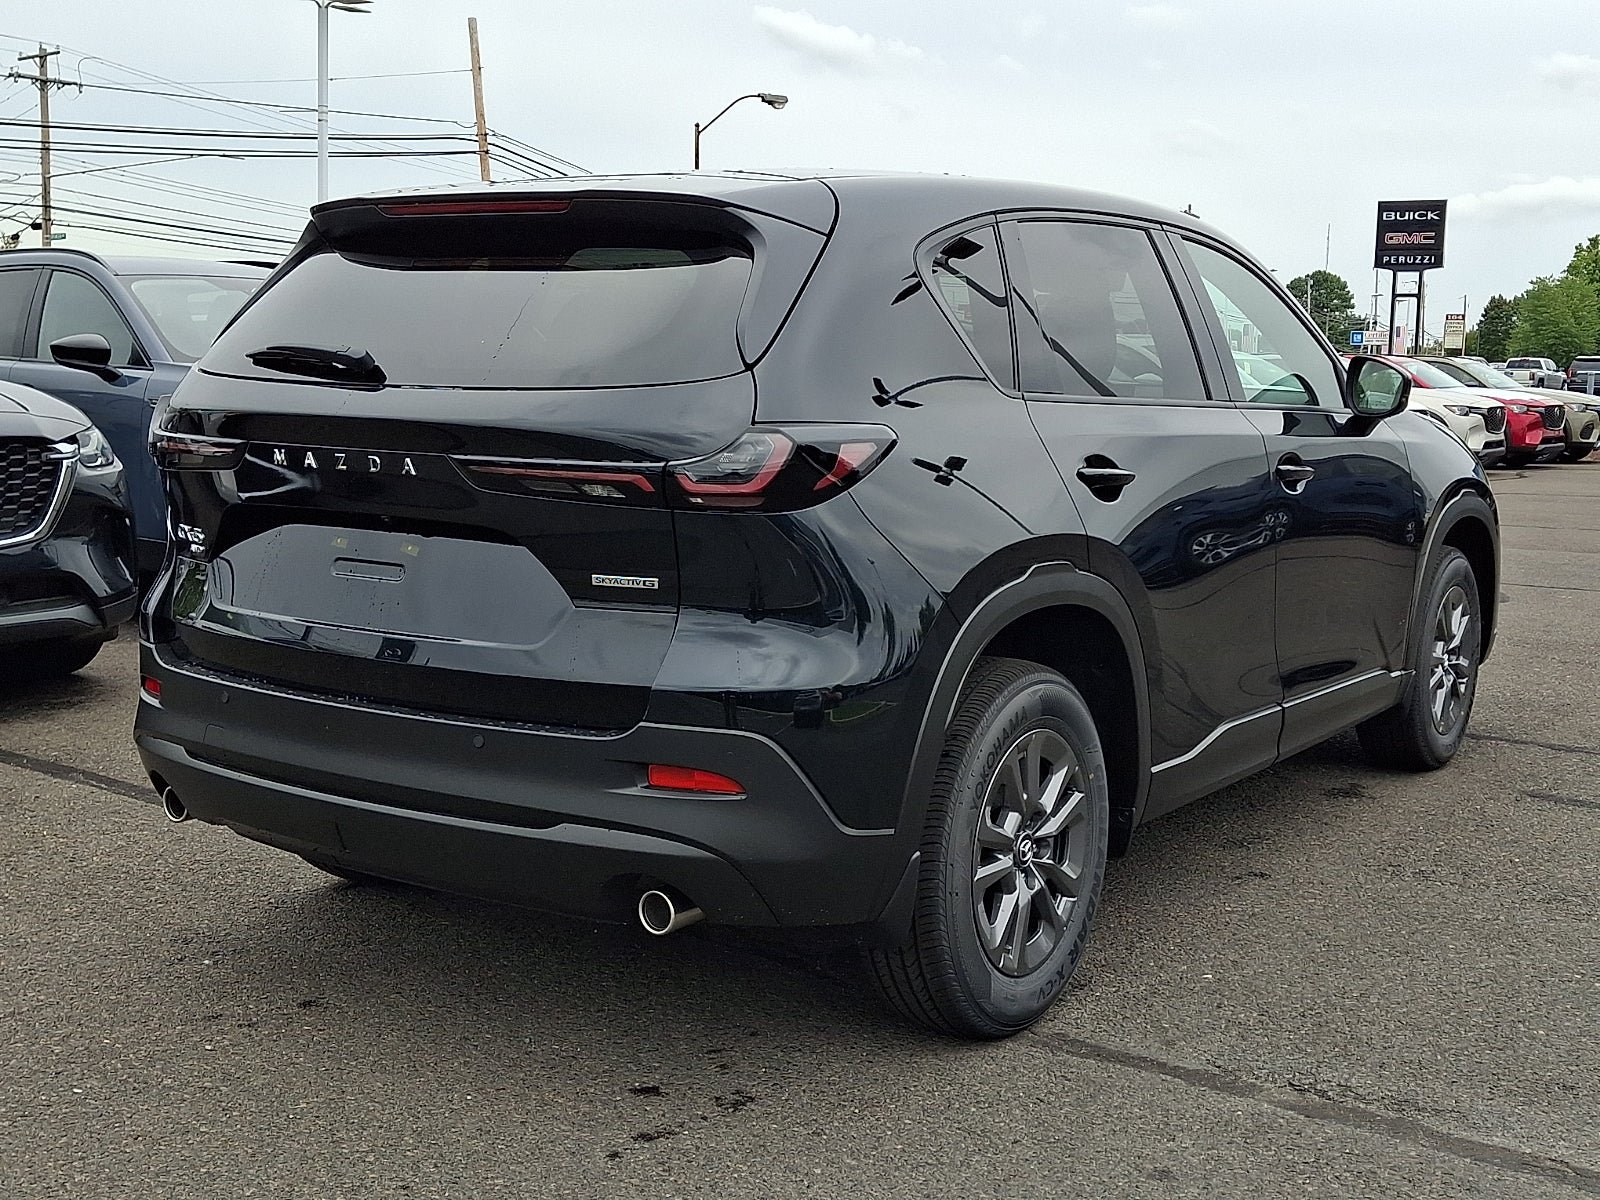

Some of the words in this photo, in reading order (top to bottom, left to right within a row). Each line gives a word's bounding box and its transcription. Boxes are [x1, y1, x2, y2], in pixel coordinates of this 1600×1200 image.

[1383, 211, 1440, 220] BUICK
[1385, 232, 1436, 244] GMC
[273, 449, 417, 476] MAZDA
[969, 705, 1028, 811] YOKOHAMA
